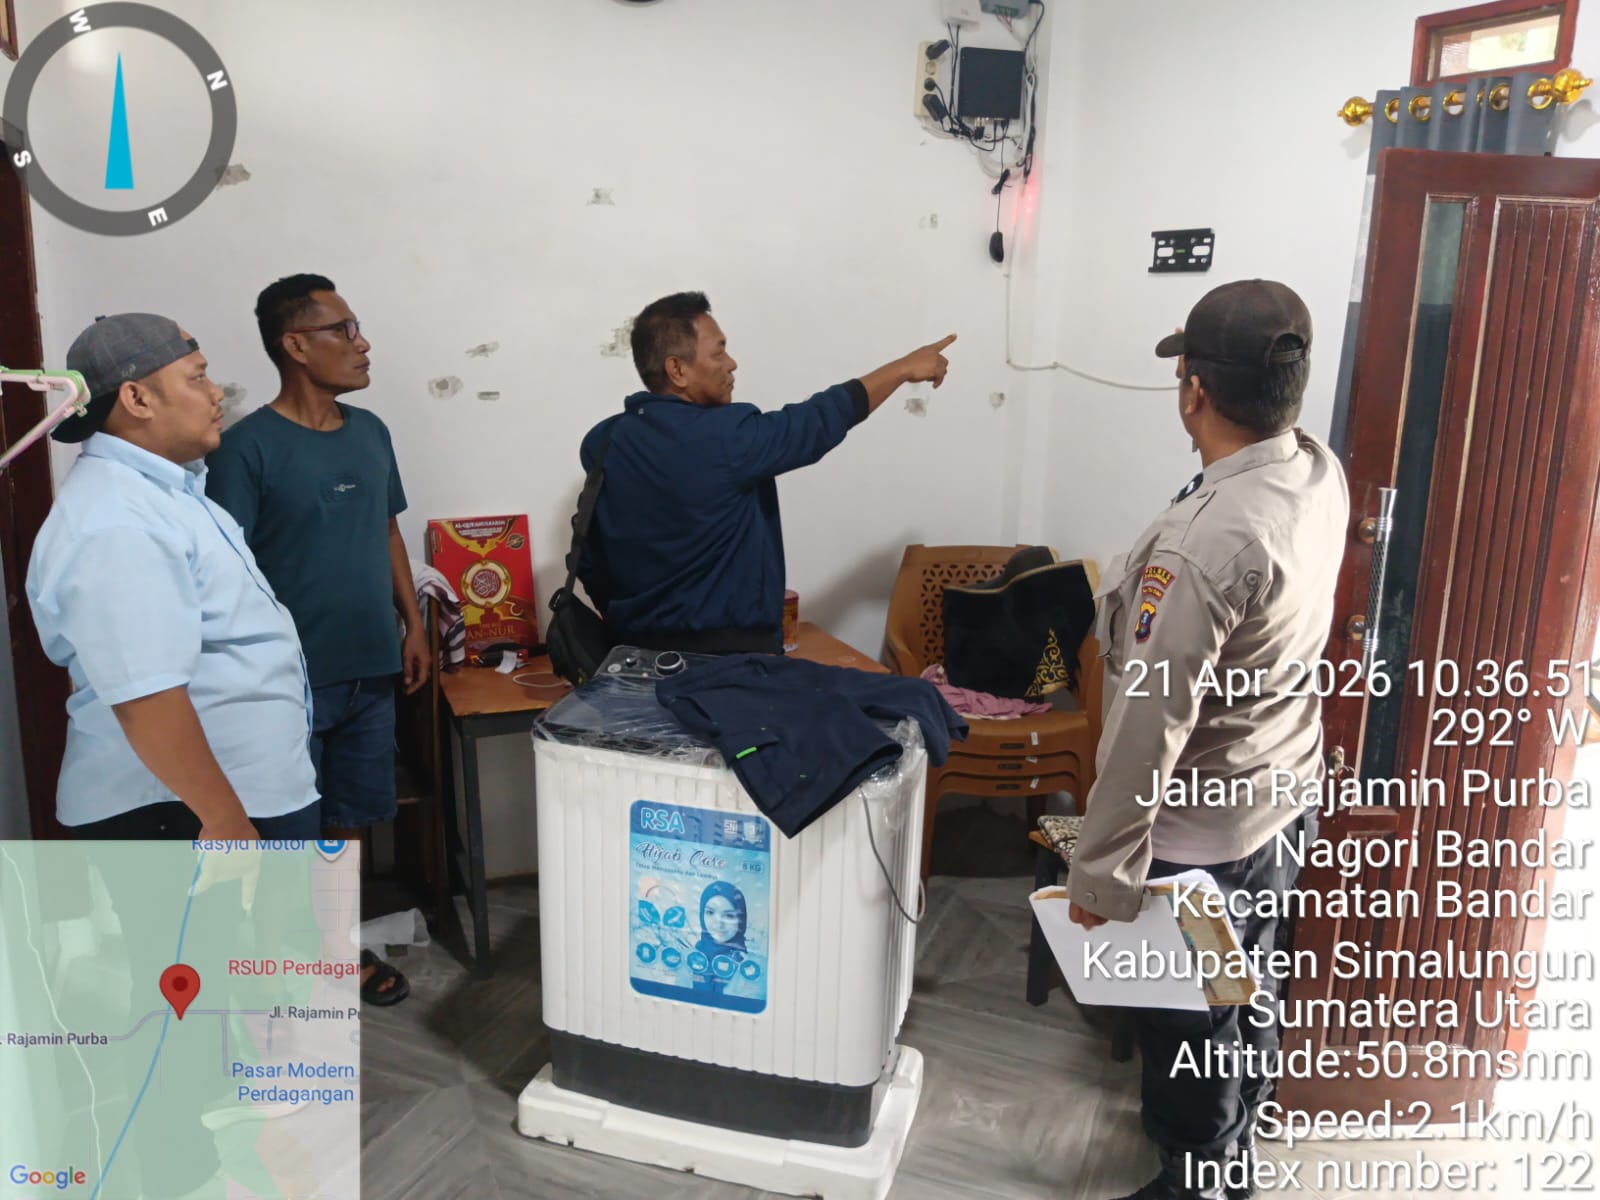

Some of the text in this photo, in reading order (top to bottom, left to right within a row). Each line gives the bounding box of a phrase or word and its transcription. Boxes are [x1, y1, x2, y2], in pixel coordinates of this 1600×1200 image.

[641, 807, 685, 834] RSA
[636, 842, 682, 864] Hijab
[689, 850, 728, 870] Care
